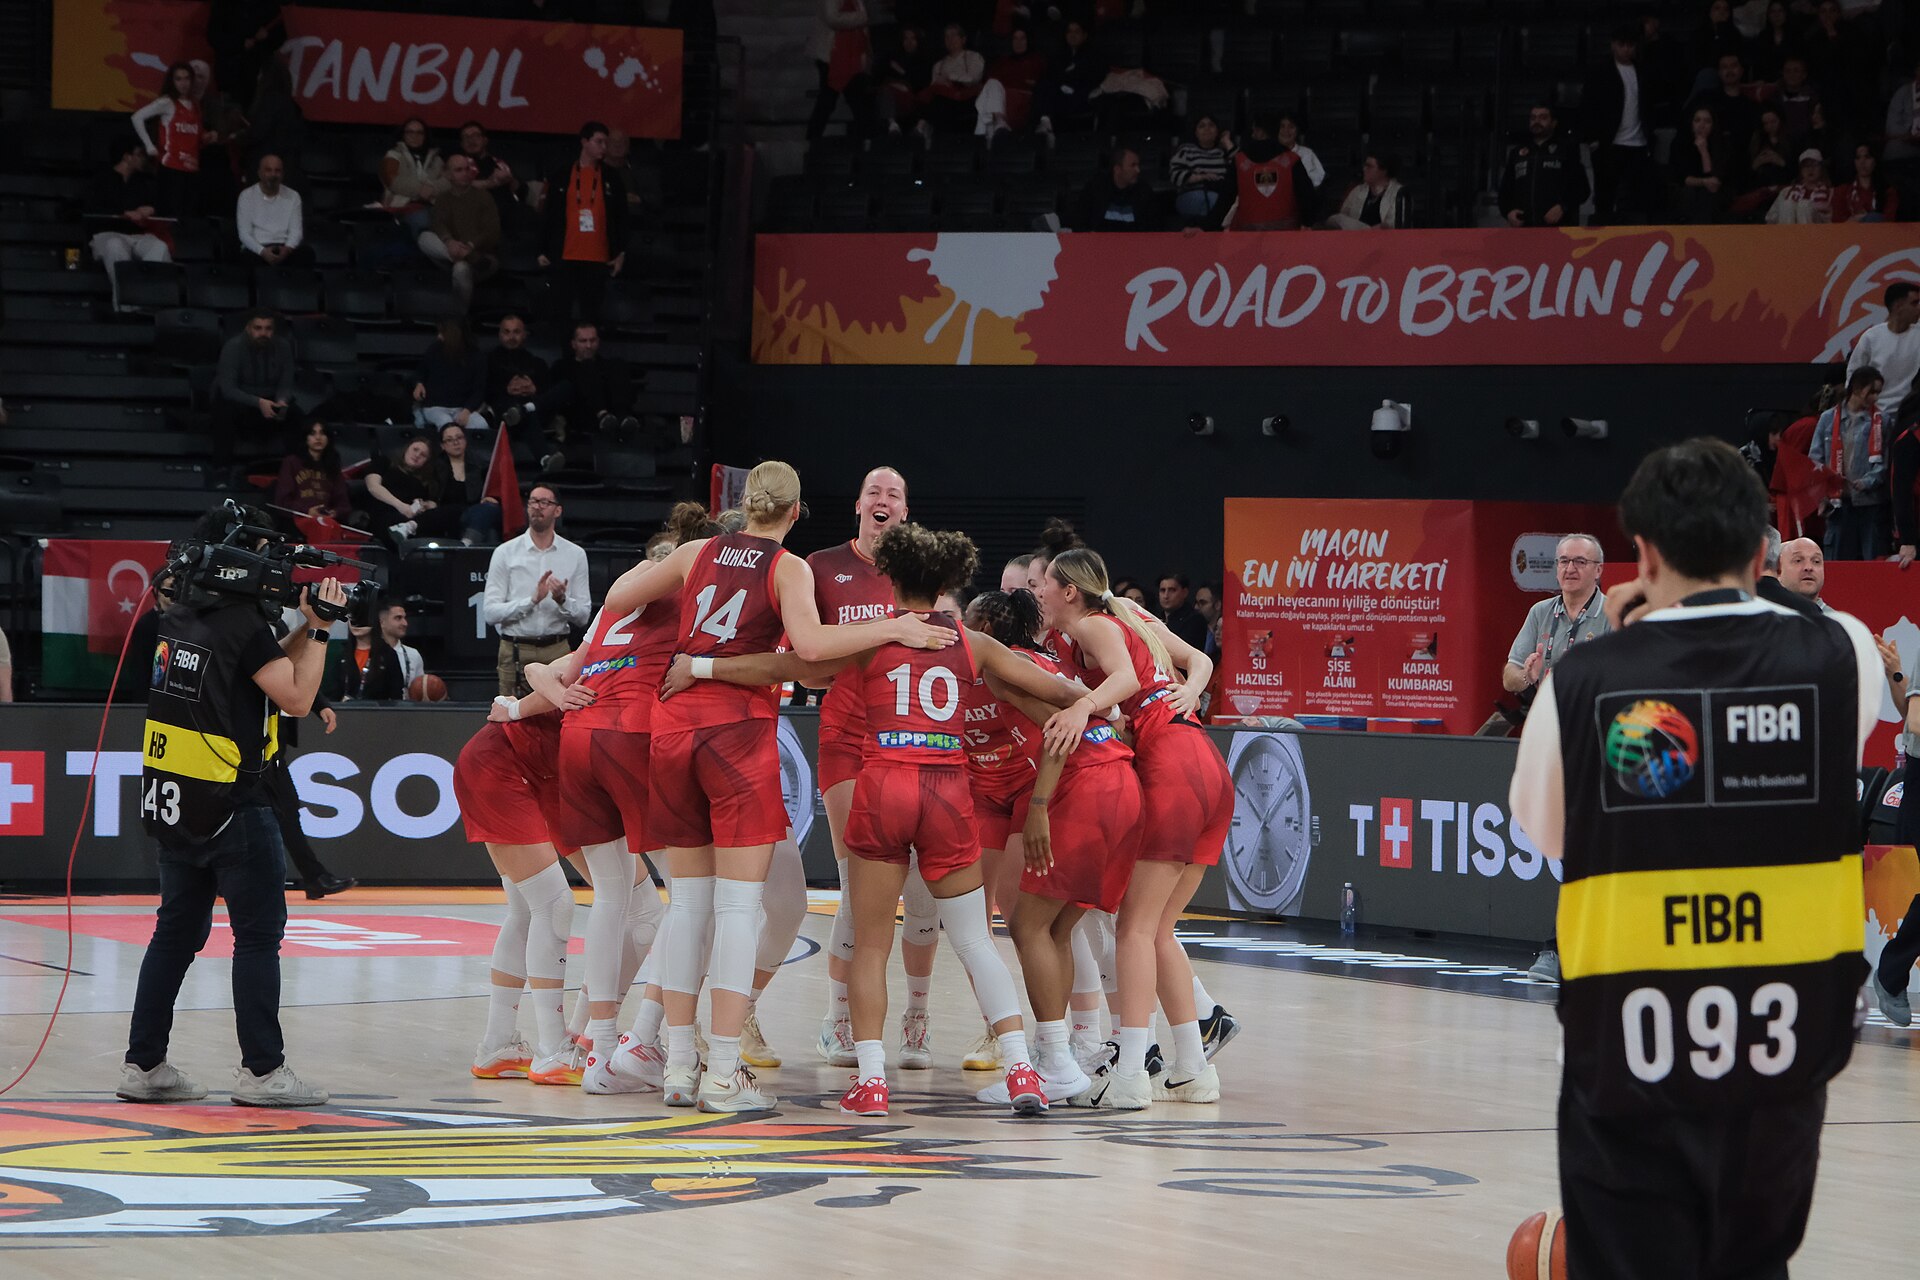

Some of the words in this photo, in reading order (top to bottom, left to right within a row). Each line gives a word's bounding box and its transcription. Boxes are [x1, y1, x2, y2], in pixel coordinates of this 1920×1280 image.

[1125, 262, 1326, 352] ROAD
[1336, 275, 1390, 324] TO
[1399, 240, 1700, 337] BERLIN!!
[713, 545, 764, 569] JUHÁSZ
[1300, 528, 1389, 561] MAÇIN
[1242, 559, 1279, 588] EN
[1286, 556, 1320, 588] İYİ
[1326, 558, 1449, 591] HAREKETİ
[689, 584, 747, 645] 14
[1239, 592, 1275, 610] Maçın
[1277, 593, 1340, 611] heyecanını
[1342, 594, 1378, 612] iyiliğe
[1380, 595, 1440, 615] dönüştür!
[1252, 658, 1266, 670] SU
[1327, 660, 1351, 677] ŞİŞE
[1403, 662, 1440, 675] KAPAK
[1235, 671, 1283, 686] HAZNESİ
[1323, 675, 1356, 688] ALANI
[1388, 678, 1453, 692] KUMBARASI
[886, 663, 960, 722] 10
[964, 702, 998, 722] ARY
[1726, 702, 1801, 743] FIBA
[148, 731, 168, 760] HB
[964, 728, 990, 747] 13
[1349, 804, 1374, 857] T
[1664, 891, 1763, 946] FIBA
[1621, 981, 1799, 1084] 093
